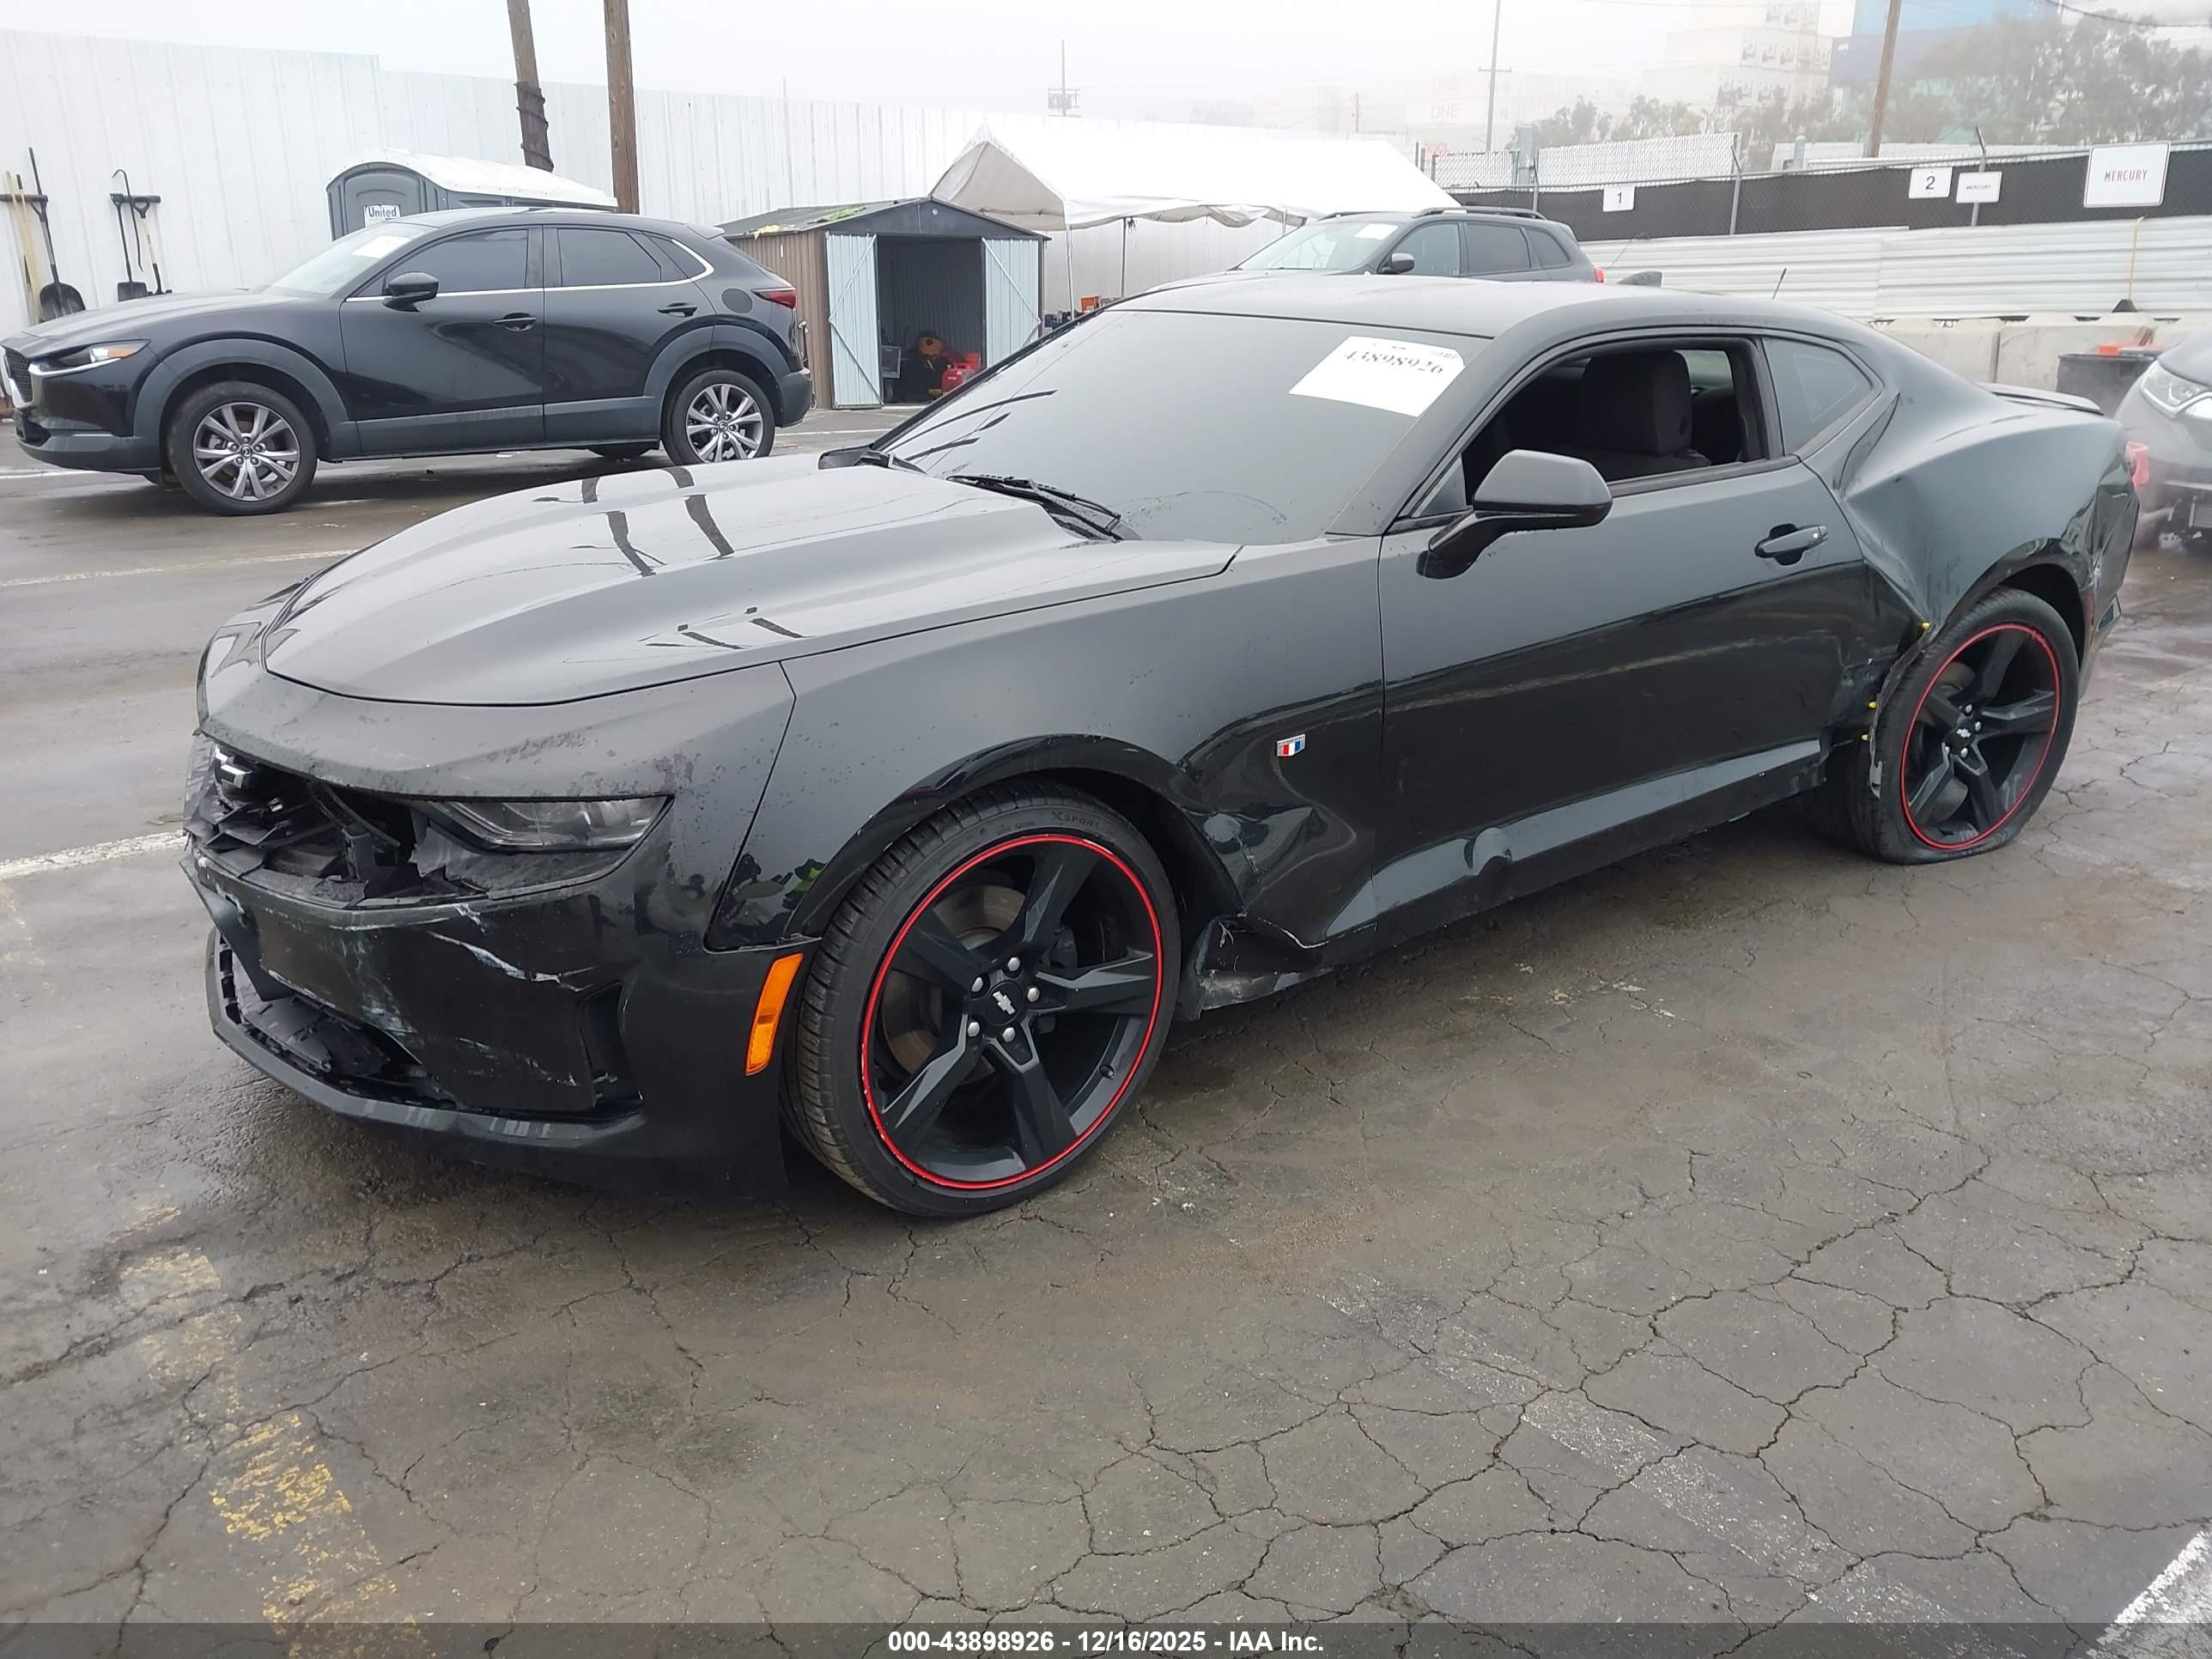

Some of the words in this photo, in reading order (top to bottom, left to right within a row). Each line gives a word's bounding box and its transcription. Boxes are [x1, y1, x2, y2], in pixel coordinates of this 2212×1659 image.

[1431, 104, 1457, 118] ONE
[2104, 168, 2148, 182] MERCURY
[1925, 175, 1936, 190] 2
[1617, 191, 1622, 204] 1
[368, 206, 397, 217] United
